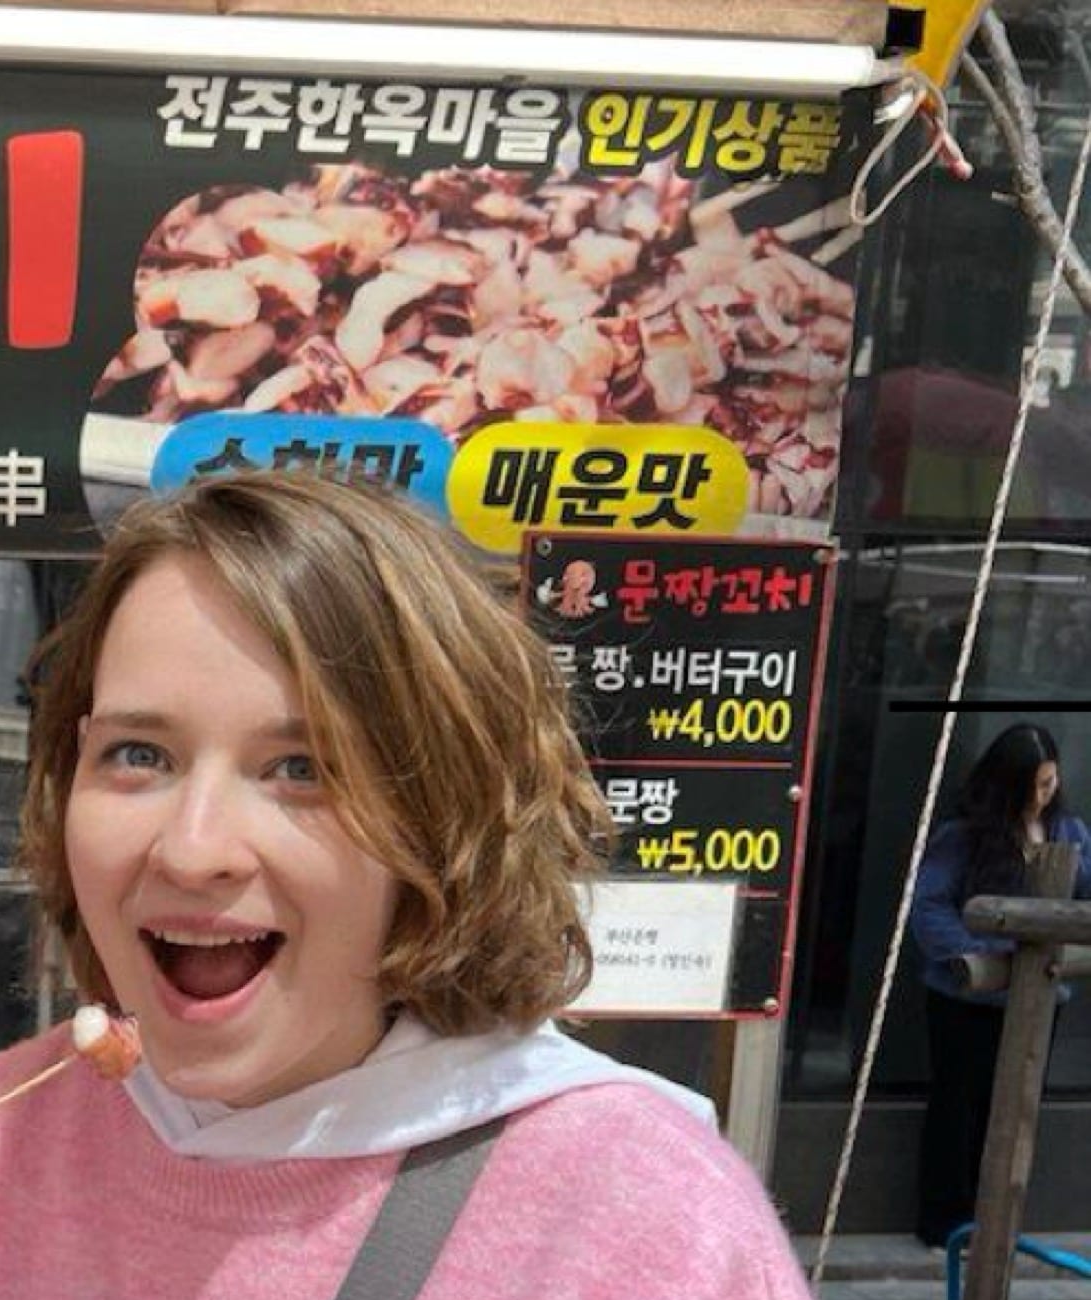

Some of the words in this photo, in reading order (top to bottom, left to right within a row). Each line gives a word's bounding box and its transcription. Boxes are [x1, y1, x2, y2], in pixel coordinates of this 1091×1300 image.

[158, 77, 559, 160] 전주한옥마을
[588, 95, 839, 171] 인기상품
[483, 448, 710, 529] 매운맛
[617, 560, 811, 621] 문짱꼬치
[648, 700, 791, 745] ₩4,000
[637, 830, 779, 874] ₩5,000
